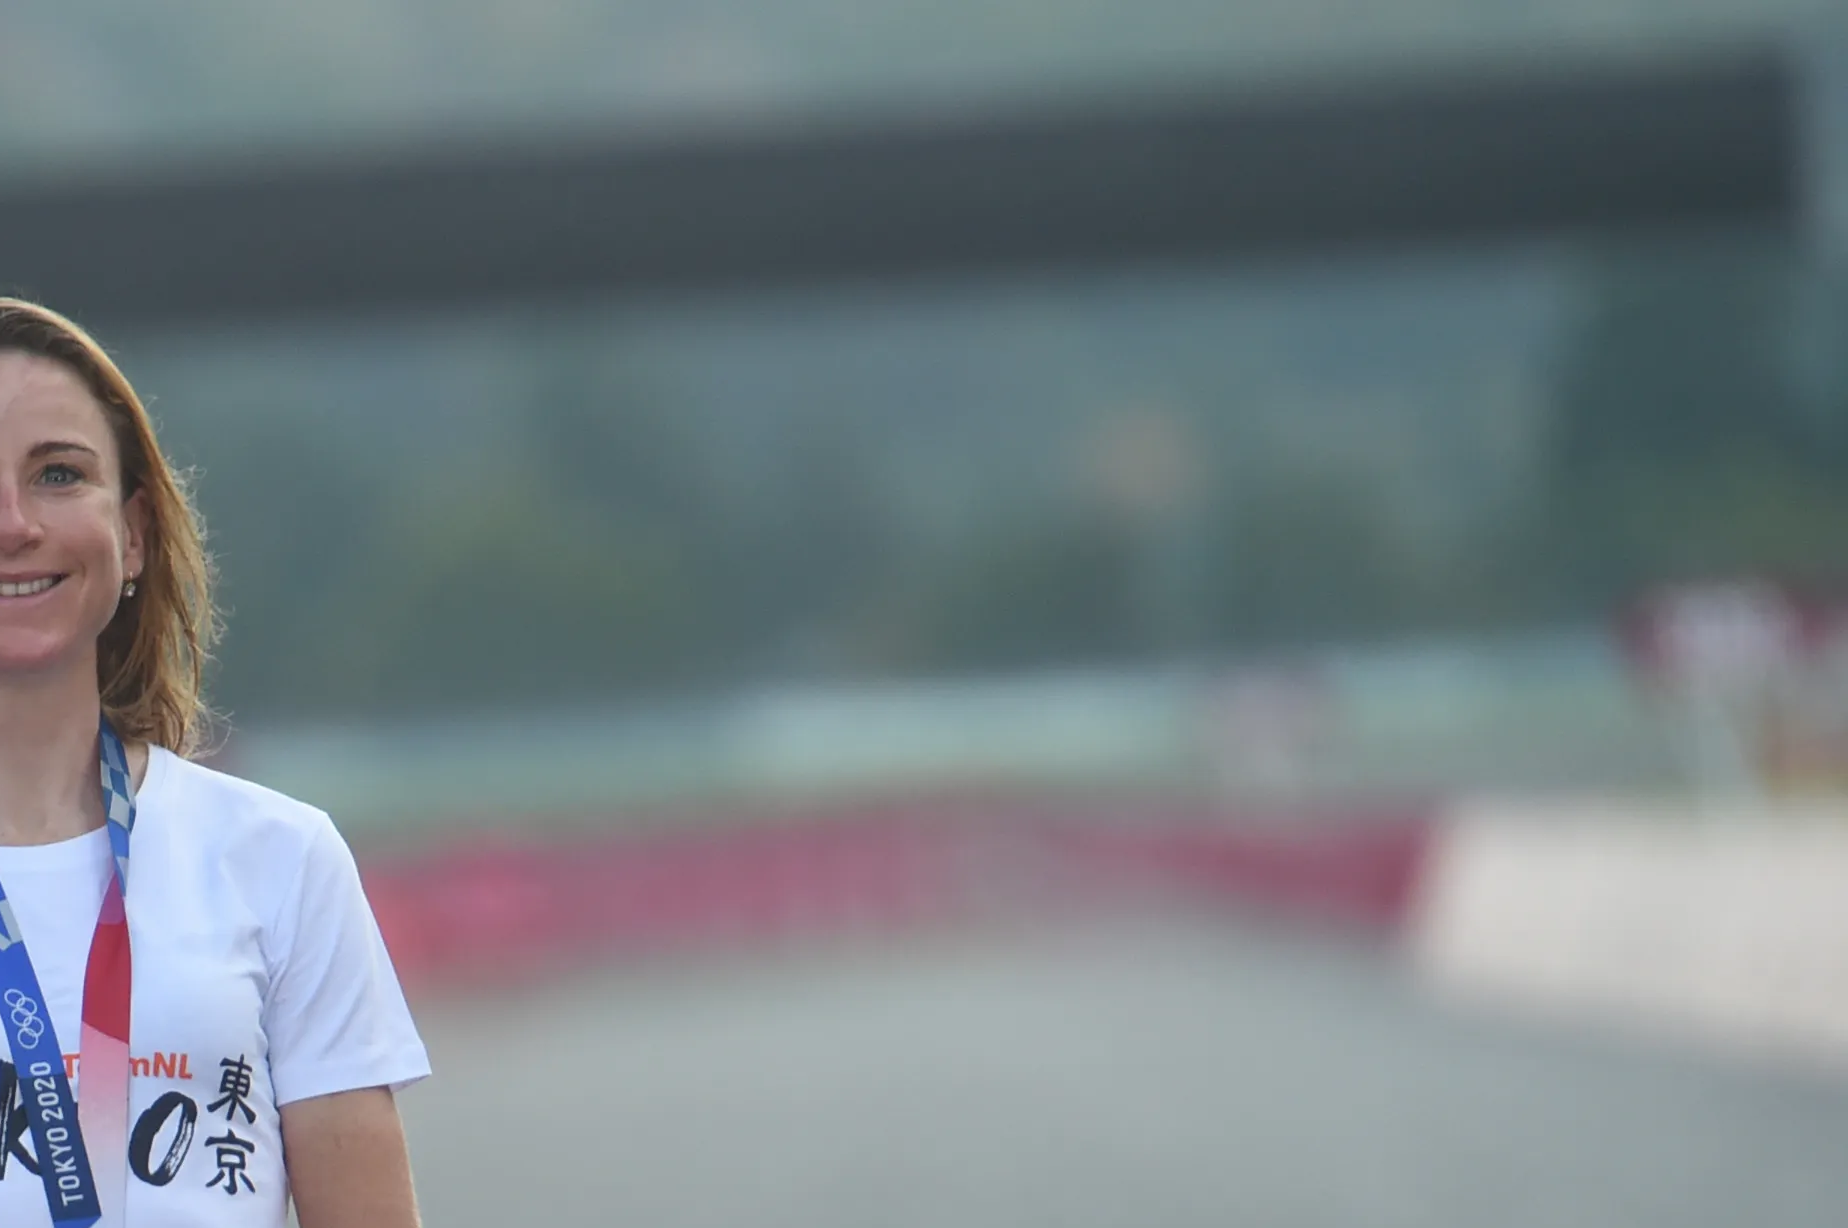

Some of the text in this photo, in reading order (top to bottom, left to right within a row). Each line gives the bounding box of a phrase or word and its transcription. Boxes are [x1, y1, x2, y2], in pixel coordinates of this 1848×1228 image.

[29, 1060, 84, 1207] TOKYO 2020
[63, 1052, 193, 1080] TmNL
[204, 1053, 256, 1195] 東京
